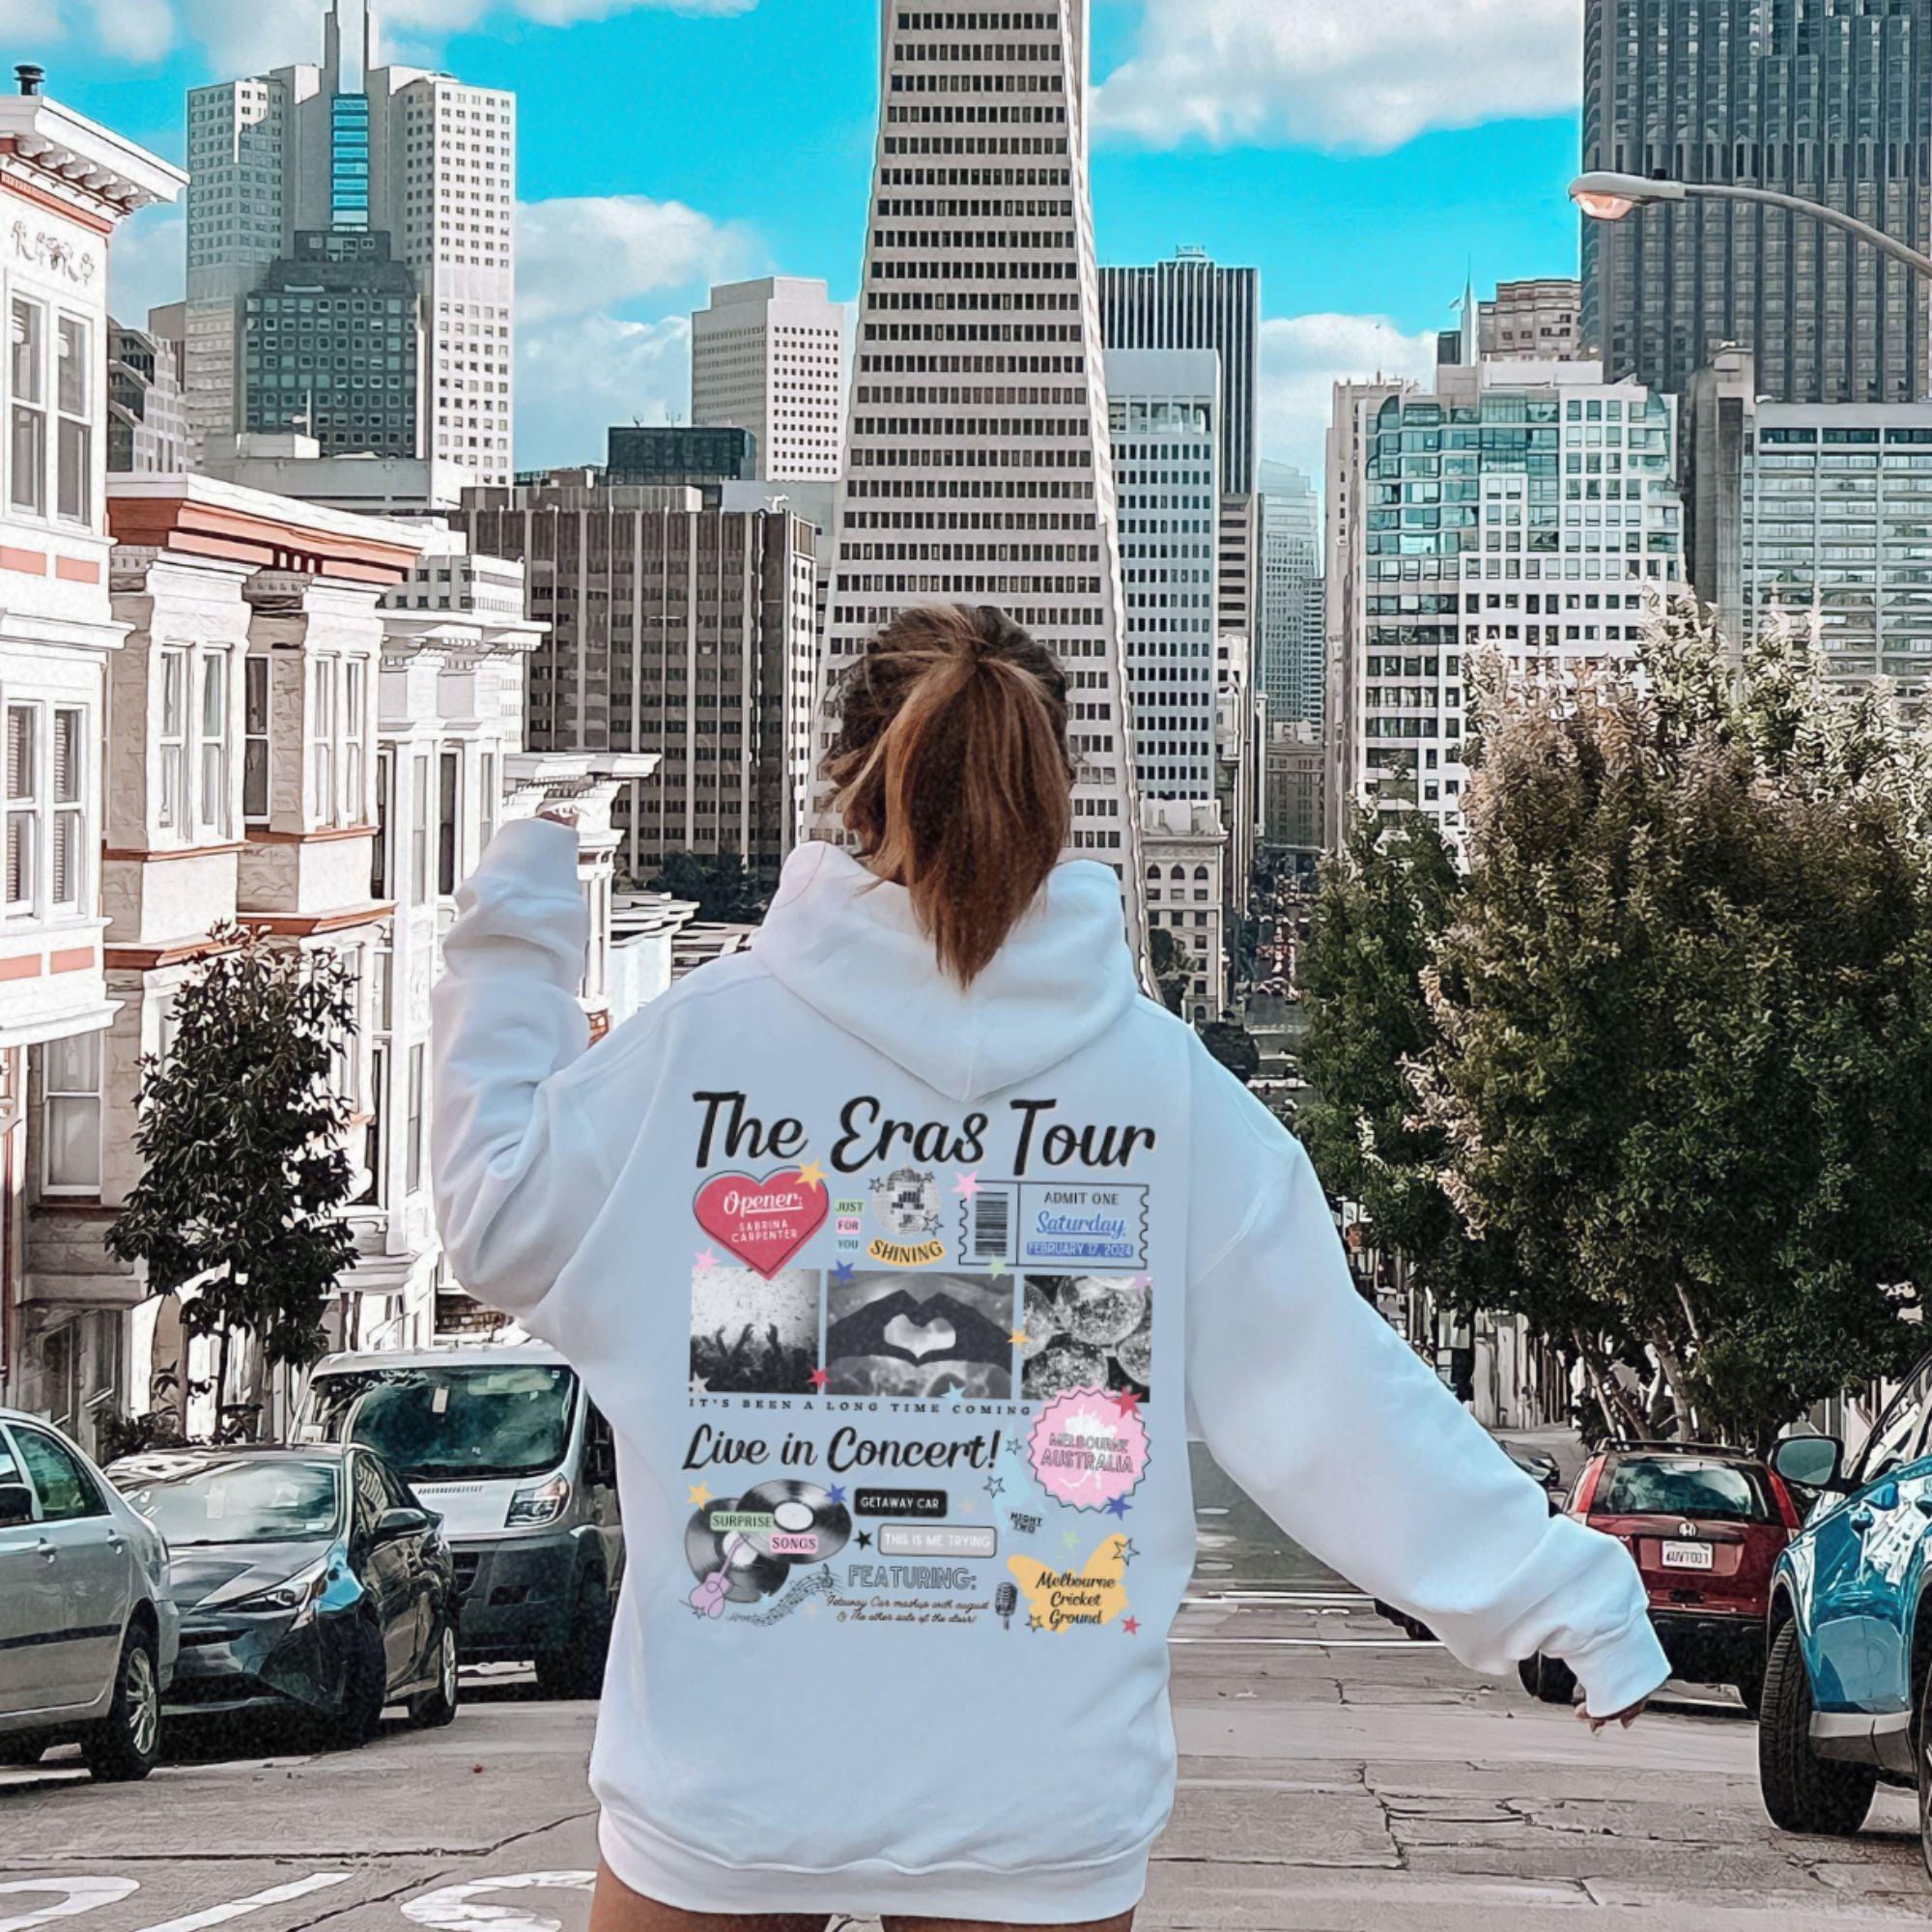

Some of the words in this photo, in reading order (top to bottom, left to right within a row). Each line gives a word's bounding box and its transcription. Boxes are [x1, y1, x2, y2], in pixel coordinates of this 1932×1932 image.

[692, 1090, 809, 1168] The
[830, 1095, 989, 1174] Eras
[1009, 1098, 1156, 1177] Tour
[1044, 1191, 1088, 1205] ADMIT
[1092, 1193, 1120, 1206] ONE
[836, 1202, 864, 1212] JUST
[739, 1218, 788, 1232] SABRINA
[838, 1219, 859, 1231] FOR
[731, 1228, 799, 1243] CARPENTER
[838, 1238, 859, 1250] YOU
[870, 1239, 943, 1264] SHINING
[1028, 1241, 1083, 1256] FEBRUARY
[1104, 1243, 1131, 1258] 2024
[689, 1398, 729, 1408] IT'S
[742, 1399, 791, 1410] BEEN
[804, 1401, 813, 1410] A
[826, 1401, 878, 1412] LONG
[891, 1403, 940, 1414] TIME
[952, 1405, 1031, 1416] COMING
[682, 1423, 770, 1470] Live
[780, 1432, 818, 1466] in
[826, 1426, 1002, 1473] Concert!
[1049, 1433, 1129, 1453] MELBOURNE
[1040, 1448, 1134, 1473] AUSTRALIA
[861, 1496, 914, 1509] GETAWAY
[918, 1498, 940, 1510] CAR
[712, 1515, 773, 1528] SURPRISE
[772, 1537, 816, 1550] SONGS
[884, 1533, 908, 1547] THIS
[912, 1534, 922, 1547] IS
[925, 1535, 944, 1548] ME
[948, 1535, 992, 1548] TRYING
[848, 1564, 978, 1591] FEATURING:
[1035, 1572, 1115, 1589] Melbourne
[870, 1596, 891, 1607] Car
[1050, 1591, 1101, 1607] Cricket
[850, 1608, 867, 1622] The
[868, 1611, 892, 1622] other
[931, 1611, 946, 1623] the
[1049, 1608, 1102, 1632] Ground
